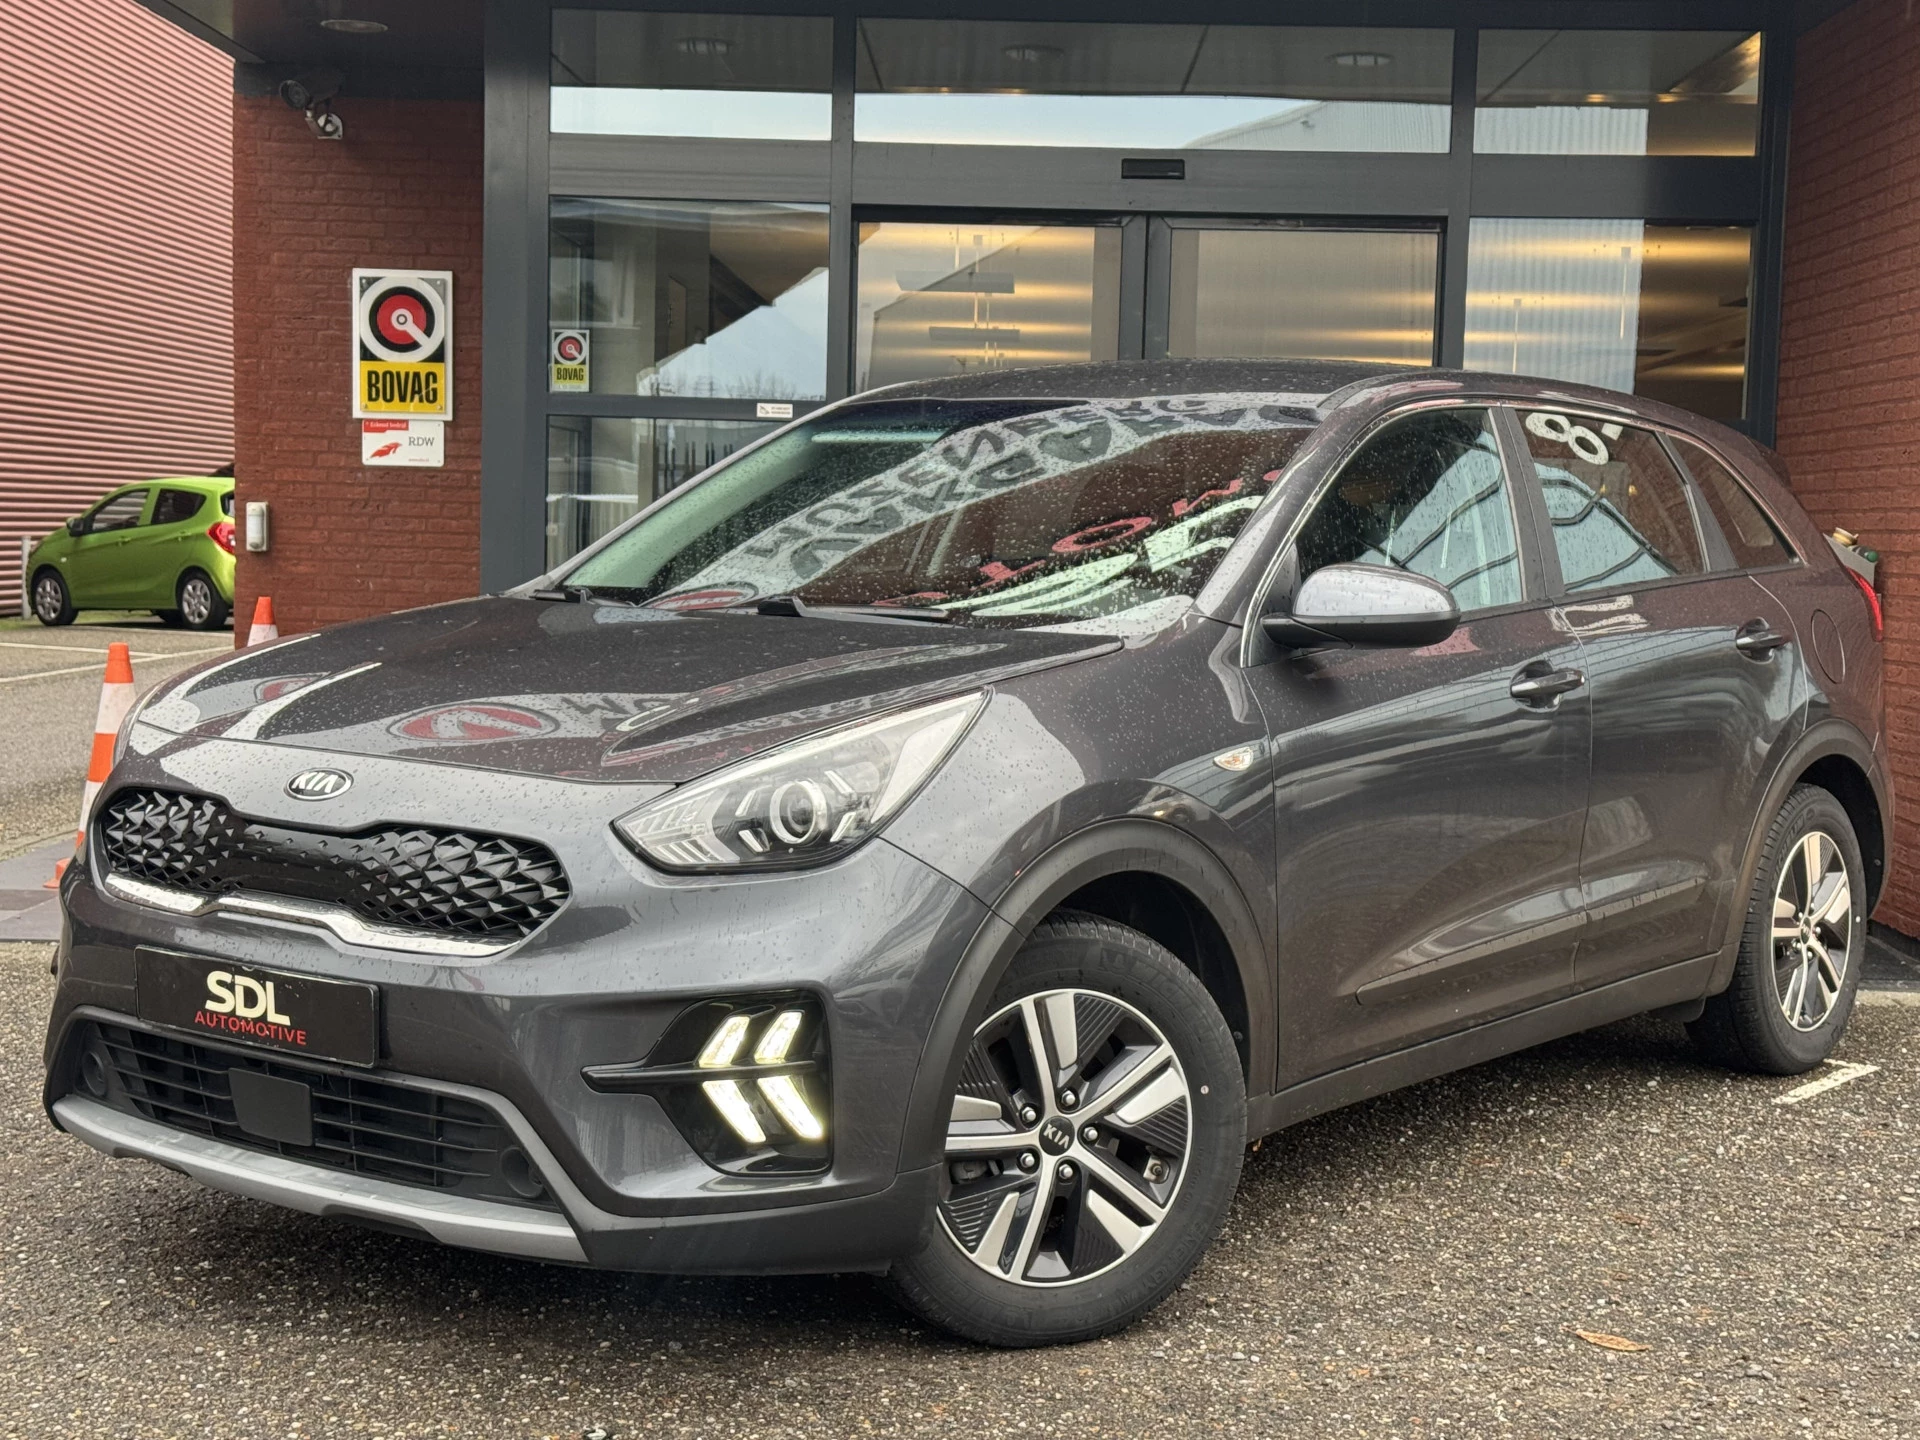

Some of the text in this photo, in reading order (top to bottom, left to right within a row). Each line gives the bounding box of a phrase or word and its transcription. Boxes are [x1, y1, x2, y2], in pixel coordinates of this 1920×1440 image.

[367, 370, 438, 404] BOVAG
[556, 367, 584, 382] BOVAG
[408, 436, 435, 447] RDW
[291, 771, 339, 794] KIA
[204, 970, 291, 1026] SDL
[194, 1010, 307, 1046] AUTOMOTIVE
[1043, 1123, 1070, 1149] KIA
